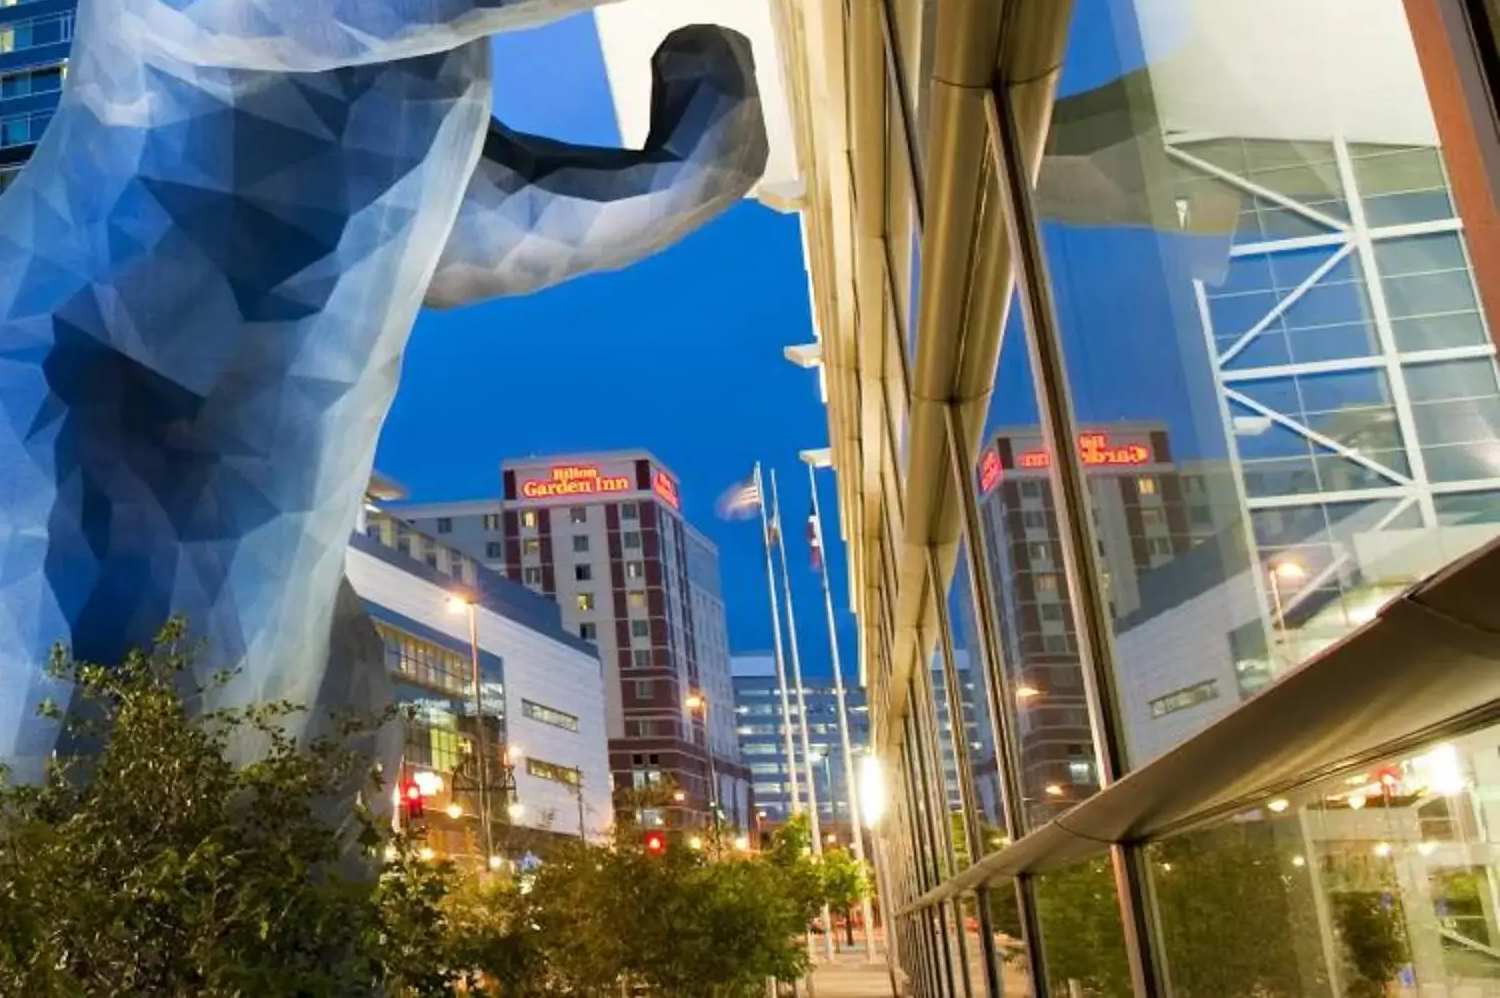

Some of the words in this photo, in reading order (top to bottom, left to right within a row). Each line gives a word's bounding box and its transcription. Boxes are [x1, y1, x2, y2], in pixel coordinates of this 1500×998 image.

[553, 466, 597, 480] Hilton
[523, 478, 592, 497] Garden
[596, 476, 629, 492] Inn
